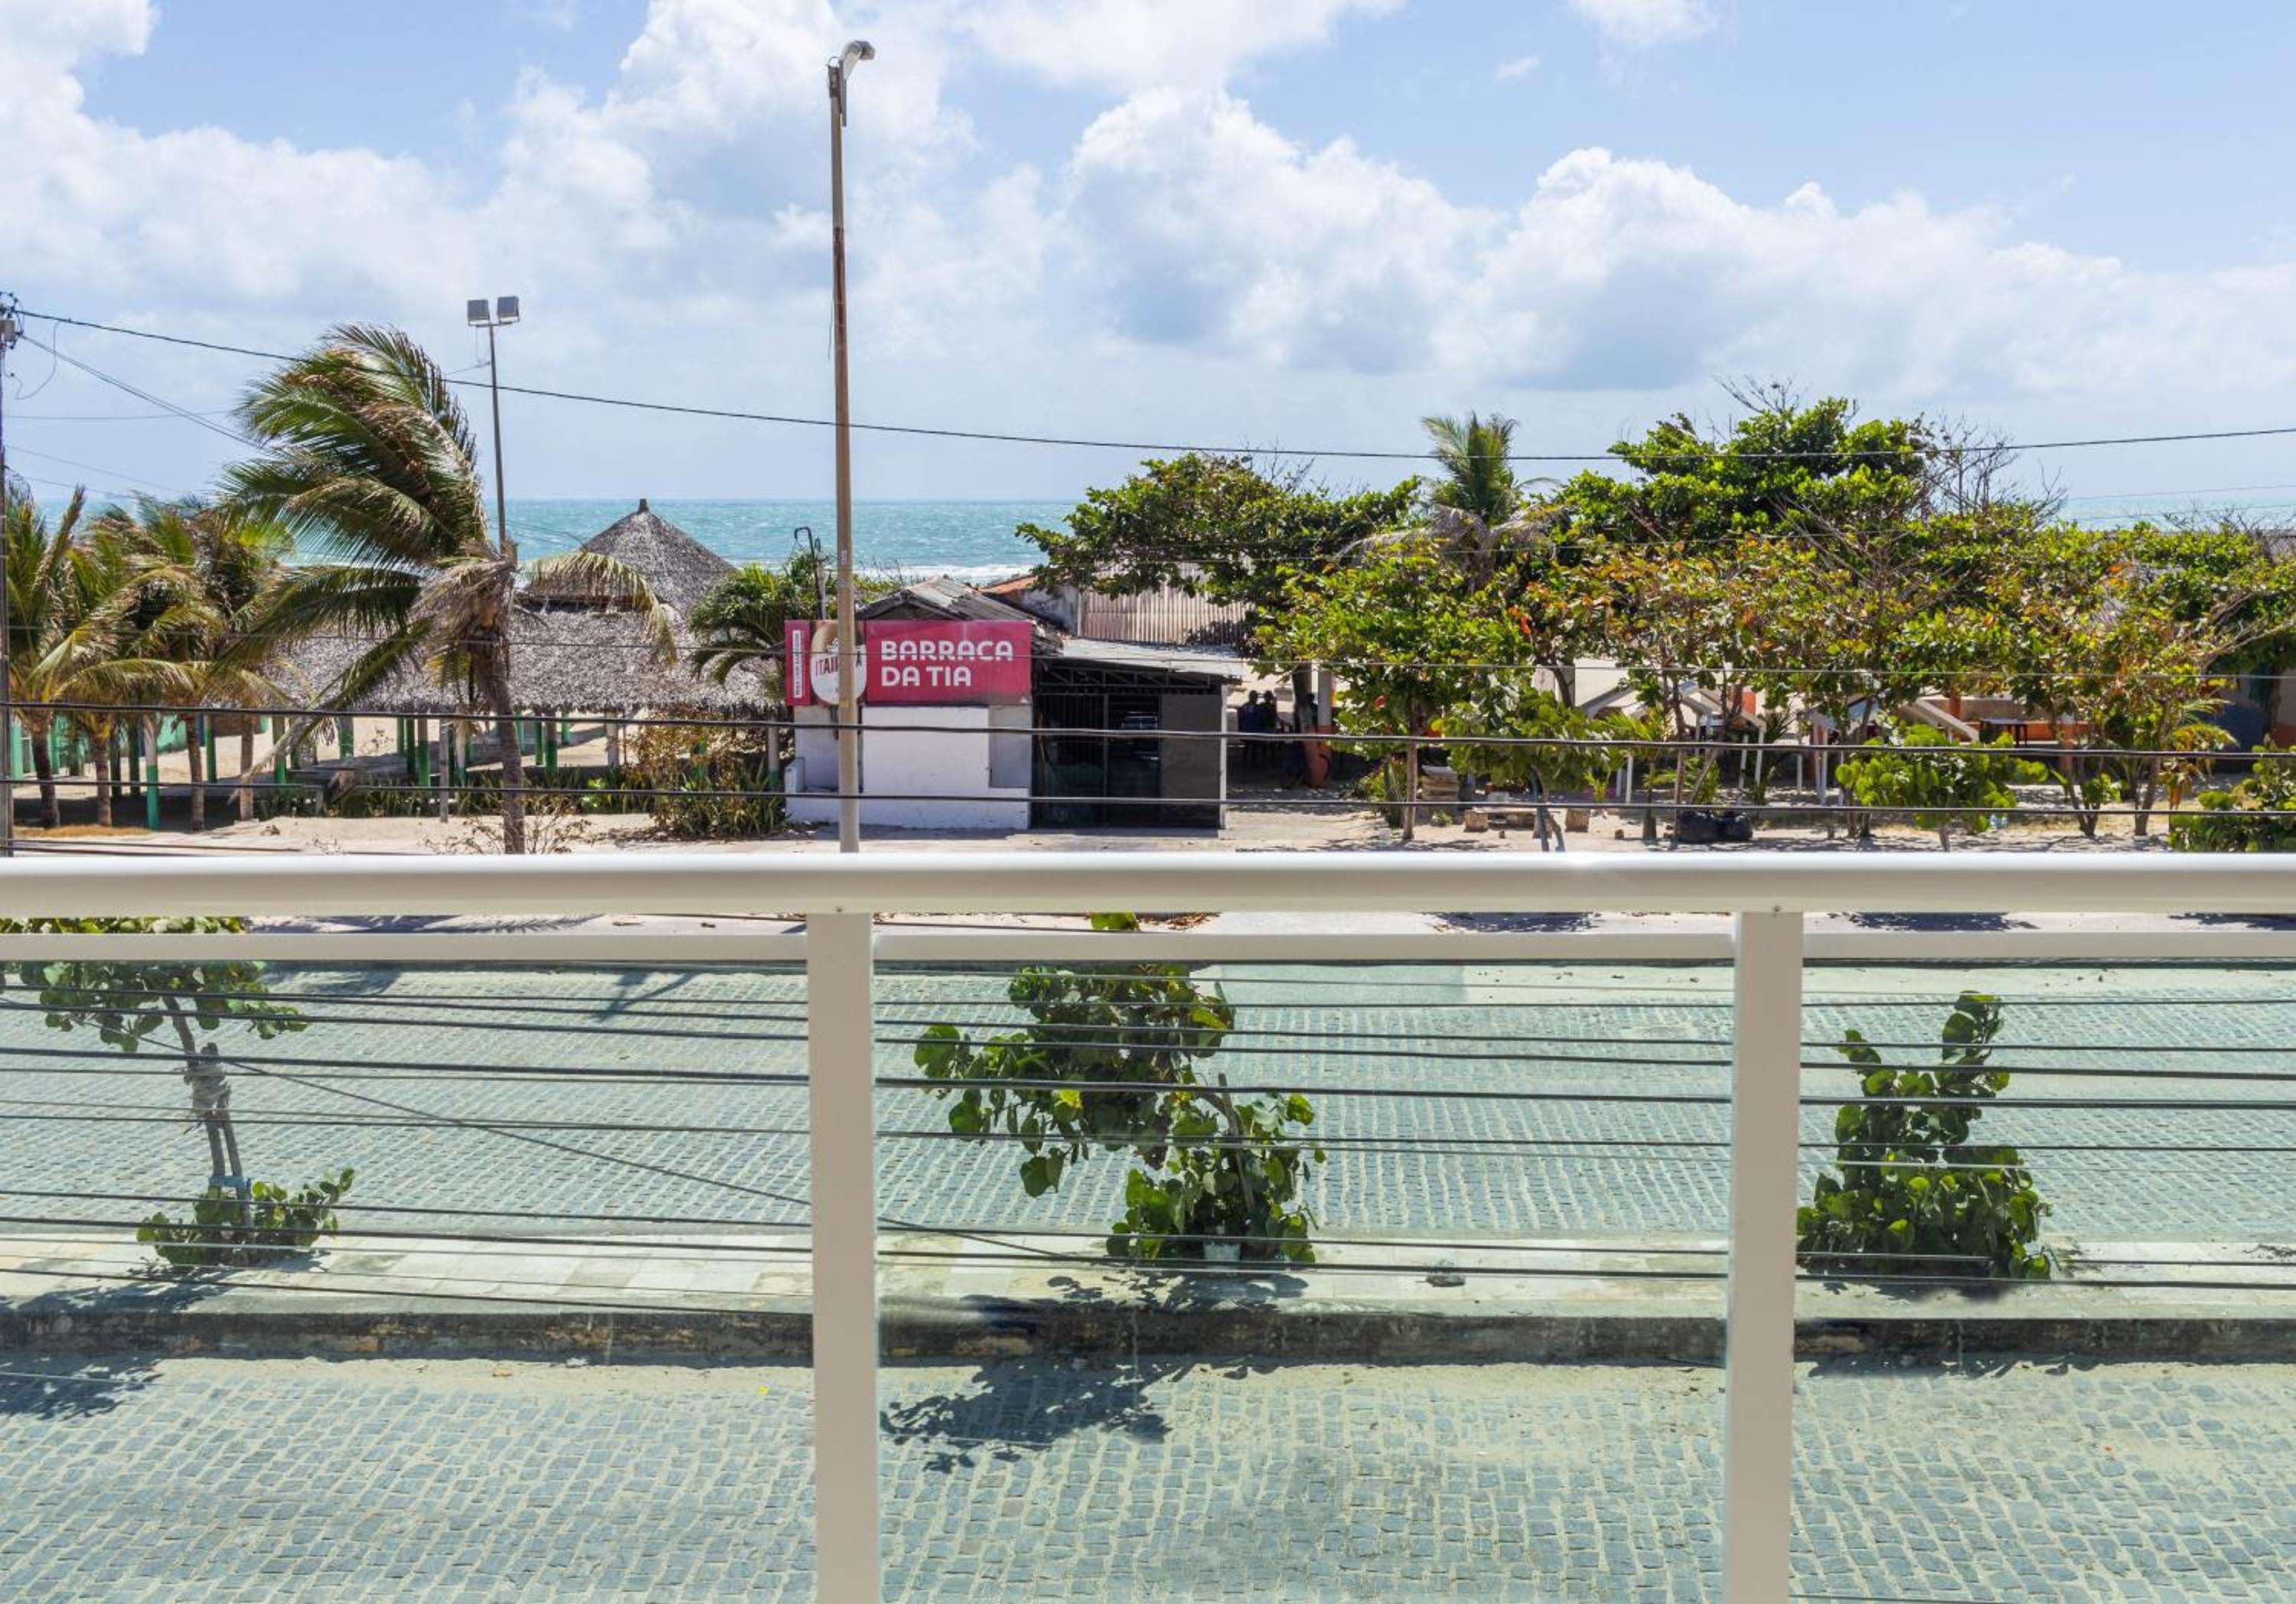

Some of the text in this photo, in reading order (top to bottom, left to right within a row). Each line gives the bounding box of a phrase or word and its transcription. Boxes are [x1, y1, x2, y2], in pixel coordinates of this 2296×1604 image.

[881, 640, 1013, 661] BARRACA
[815, 650, 863, 676] ITAIA
[881, 666, 972, 686] DA TIA
